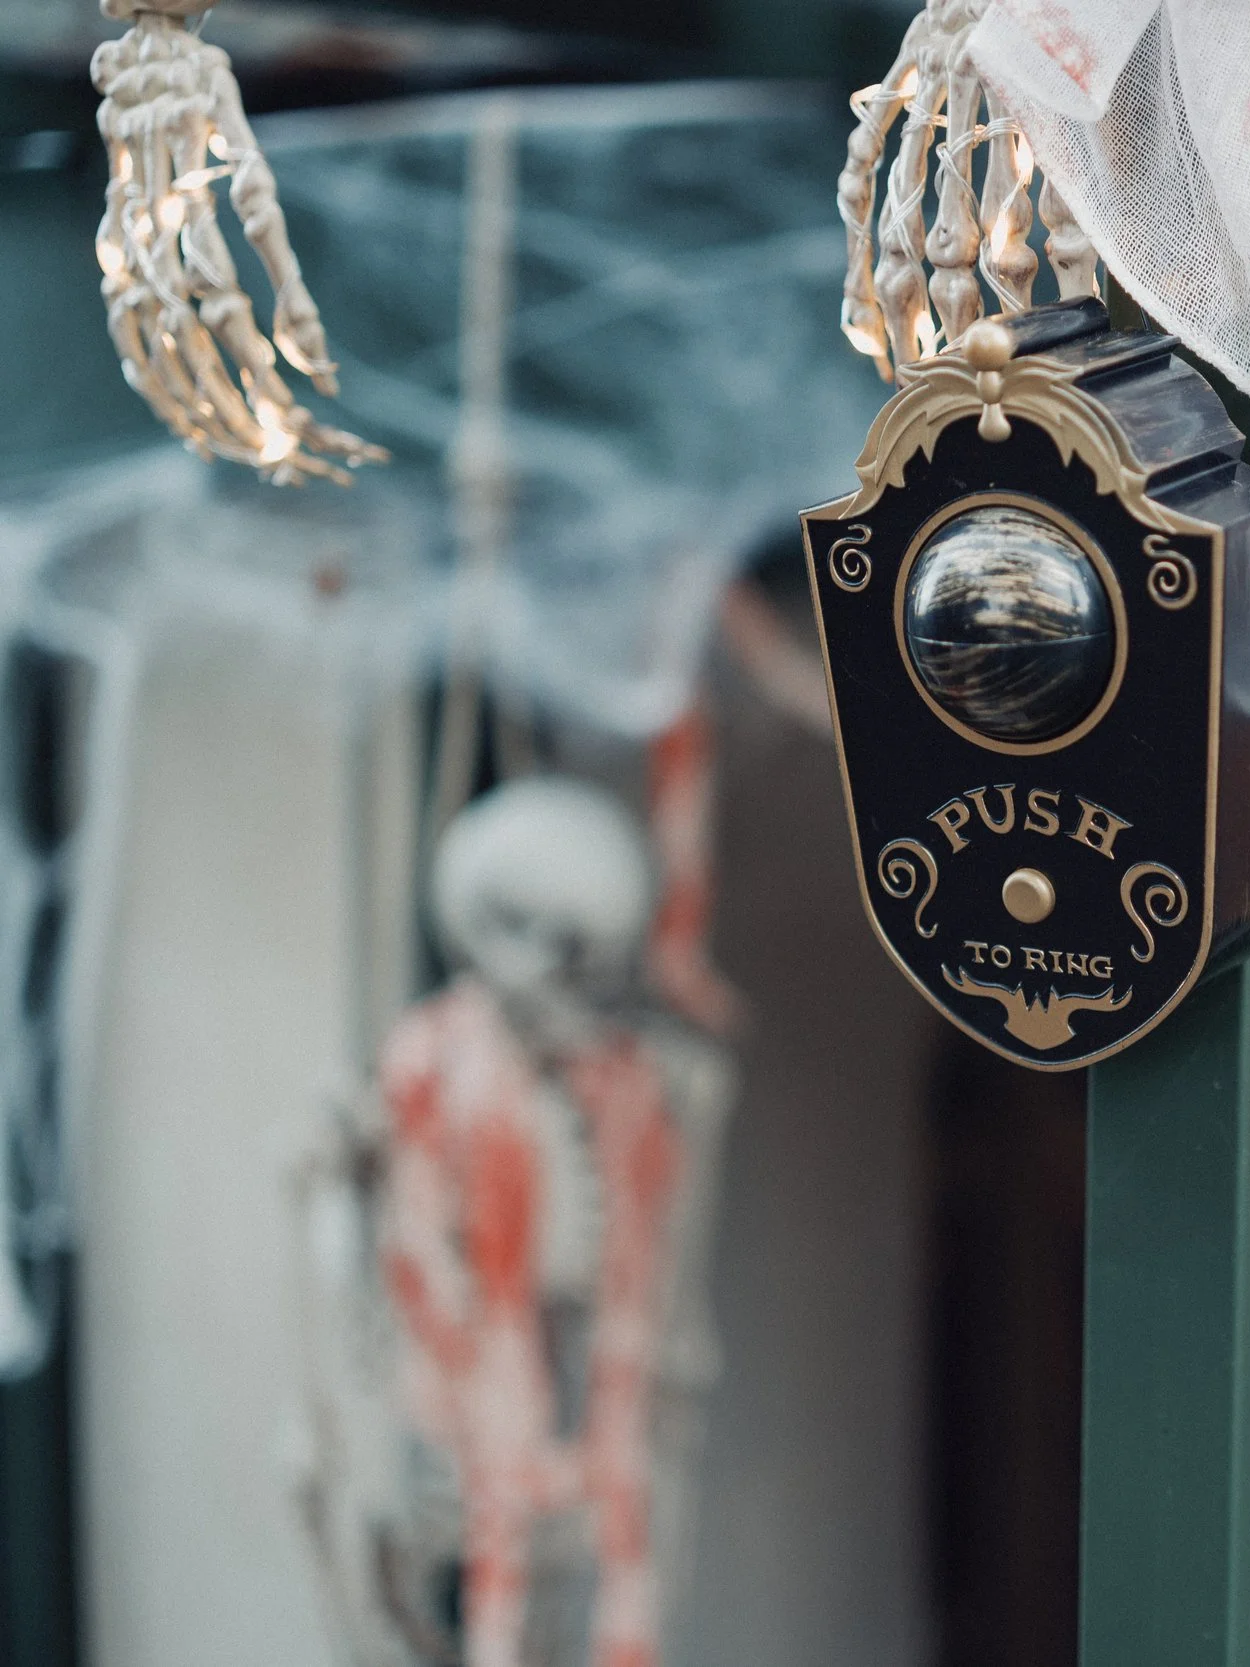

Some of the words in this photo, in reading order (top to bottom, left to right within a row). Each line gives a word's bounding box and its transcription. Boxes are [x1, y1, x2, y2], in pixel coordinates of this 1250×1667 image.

[927, 783, 1134, 860] PUSH
[963, 940, 1013, 969] TO
[1020, 946, 1115, 979] RING
